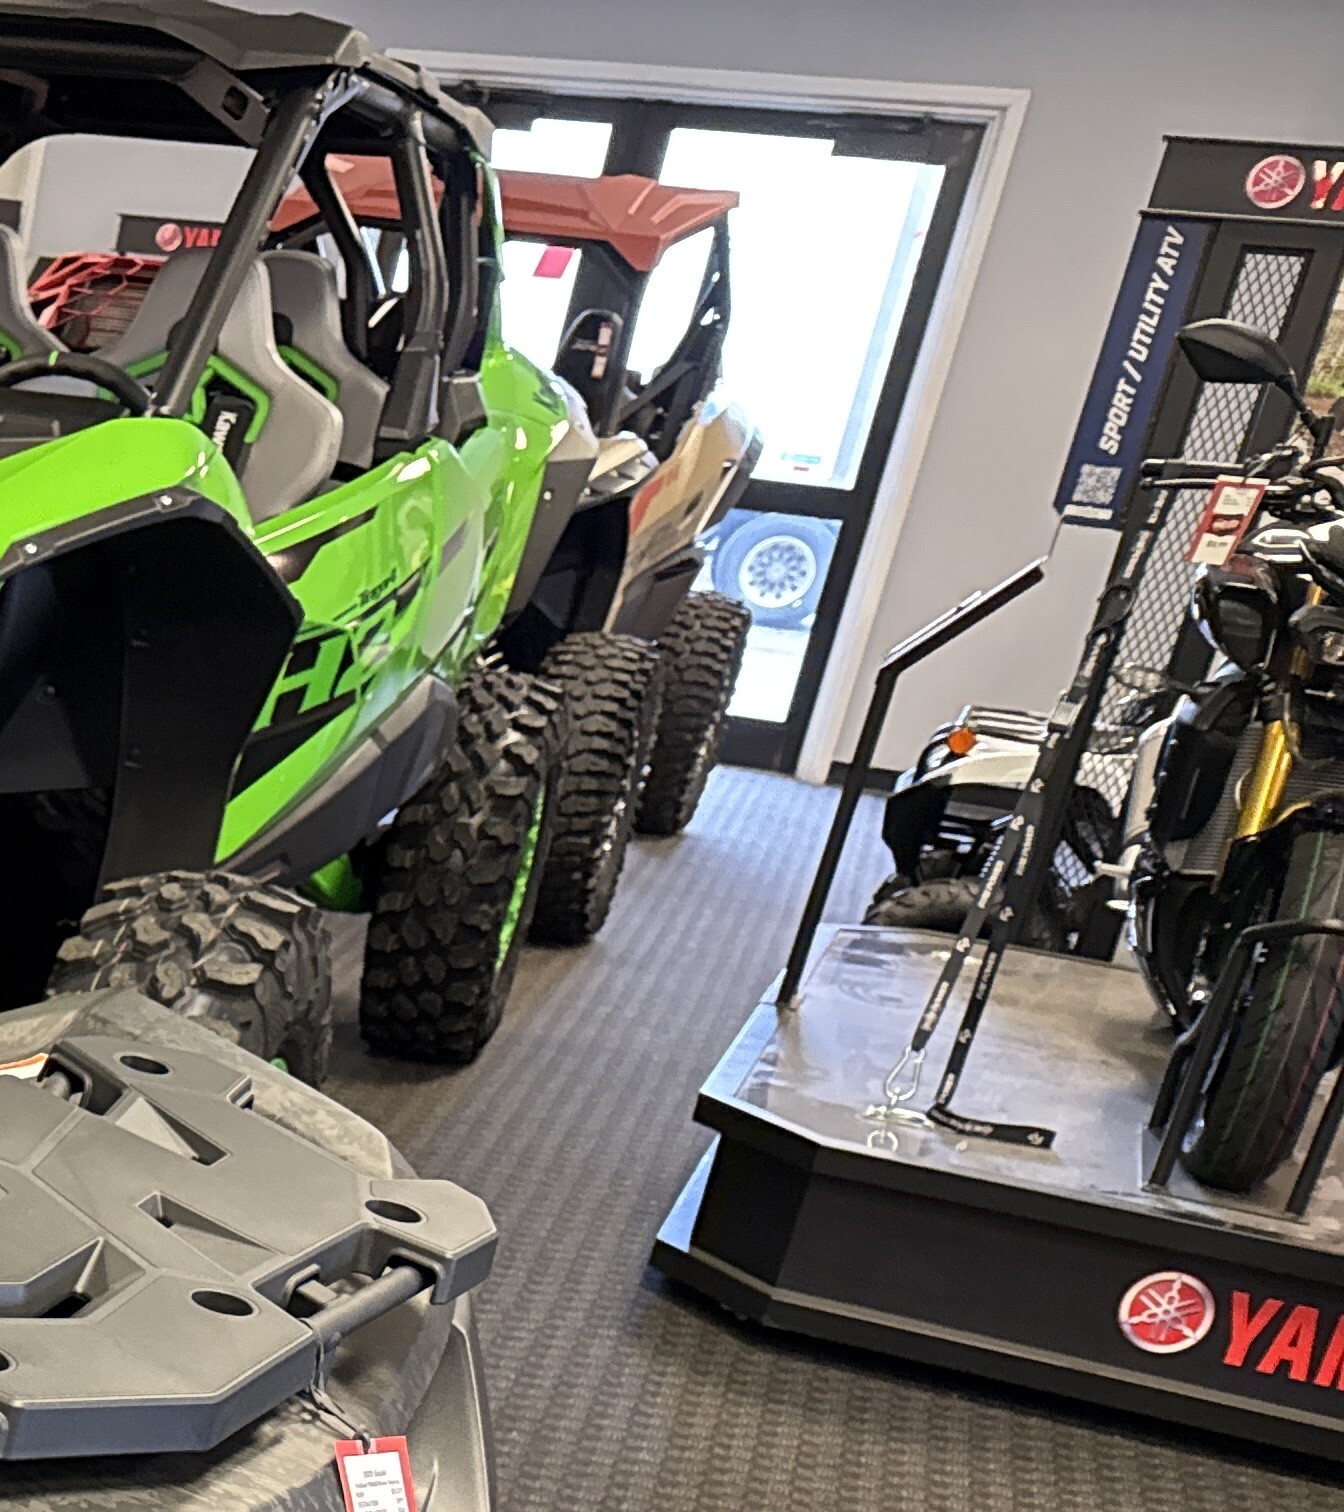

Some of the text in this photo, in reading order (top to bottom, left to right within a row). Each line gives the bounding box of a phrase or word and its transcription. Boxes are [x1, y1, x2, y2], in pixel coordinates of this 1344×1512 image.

[1098, 377, 1137, 456] SPORT
[1128, 272, 1170, 363] UTILITY
[1155, 225, 1186, 277] ATV
